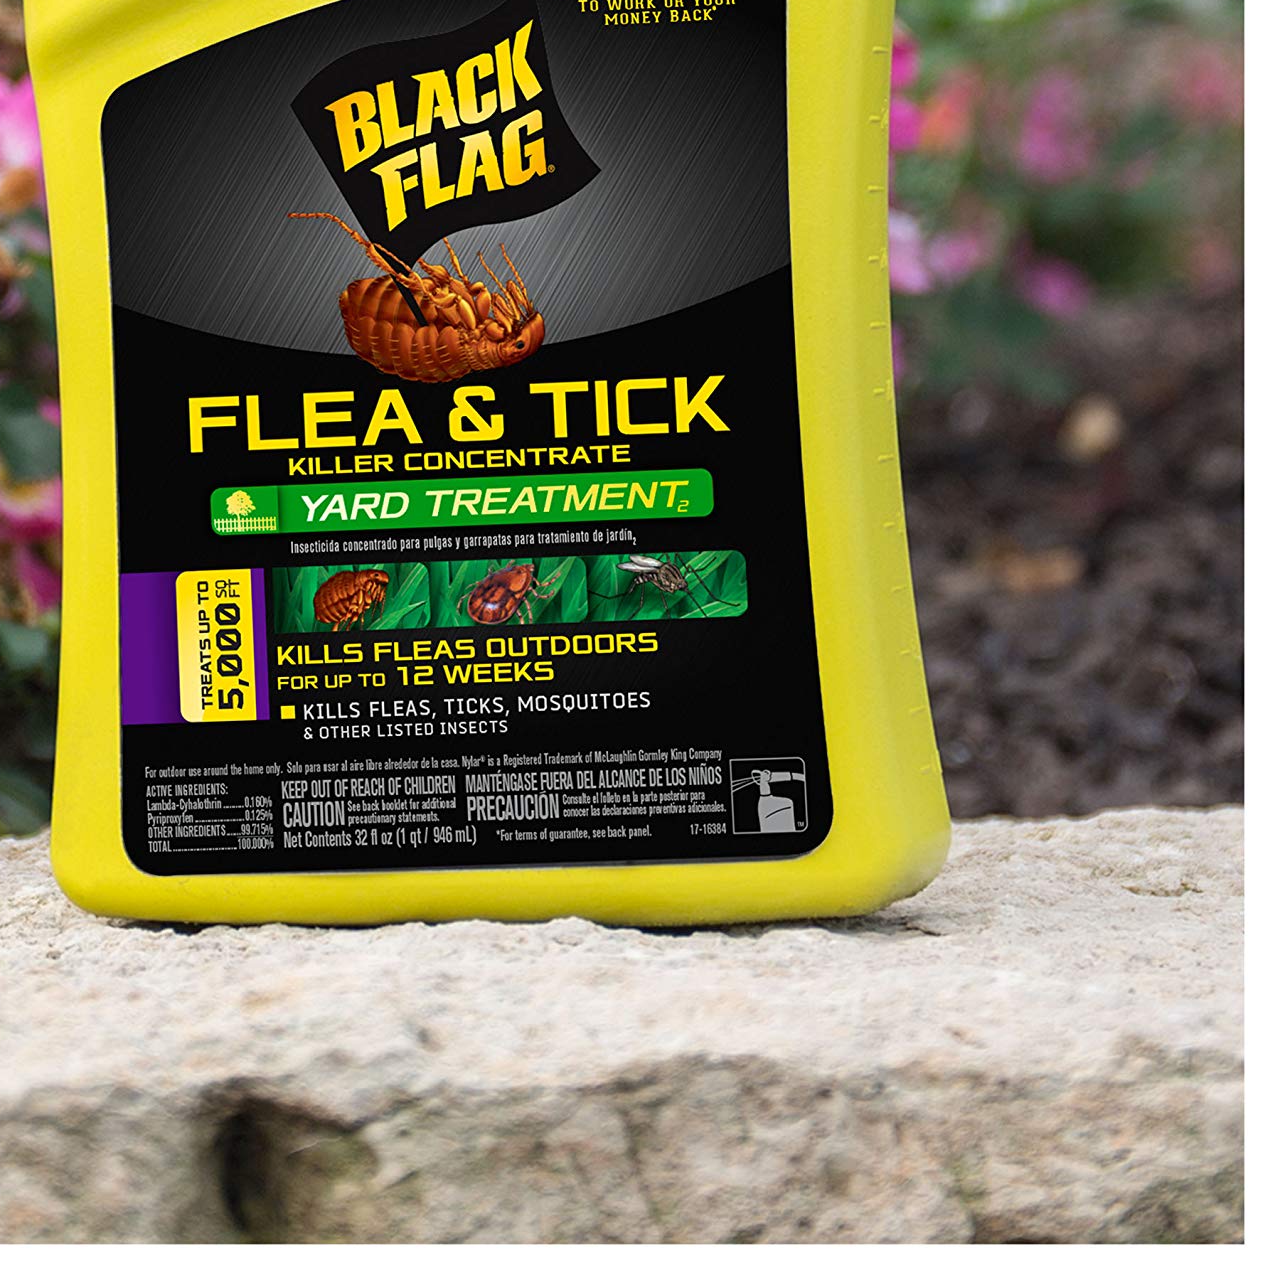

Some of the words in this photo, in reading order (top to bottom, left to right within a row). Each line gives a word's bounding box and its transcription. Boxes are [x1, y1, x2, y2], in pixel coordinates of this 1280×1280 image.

[578, 0, 598, 12] TO
[605, 11, 661, 25] MONEY
[324, 19, 543, 172] BLACK
[189, 389, 423, 453] FLEA
[449, 386, 504, 441] &
[530, 375, 730, 438] TICK
[289, 455, 393, 475] KILLER
[404, 445, 630, 470] CONCENTRATE
[302, 492, 409, 521] YARD
[291, 540, 339, 553] Insecticida
[343, 538, 397, 551] concentrado
[400, 539, 420, 551] para
[424, 536, 452, 551] pulgas
[455, 537, 460, 549] y
[464, 534, 511, 549] garrapatas
[515, 534, 534, 547] para
[538, 531, 589, 544] tratamiento
[593, 530, 603, 542] de
[197, 581, 209, 605] TO
[215, 579, 228, 598] SQ
[228, 579, 240, 598] FT
[198, 609, 210, 634] UP
[215, 603, 250, 709] 5,000
[277, 643, 363, 665] KILLS
[374, 639, 475, 661] FLEAS
[486, 633, 658, 657] OUTDOORS
[200, 638, 213, 710] TREATS
[278, 676, 318, 690] FOR
[325, 675, 351, 688] UP
[358, 673, 385, 687] TO
[397, 666, 433, 685] 12
[443, 661, 554, 684] WEEKS
[304, 702, 360, 720] KILLS
[370, 700, 436, 719] FLEAS,
[444, 697, 509, 716] TICKS,
[518, 692, 650, 712] MOSQUITOES
[304, 727, 312, 739] &
[320, 725, 370, 739] OTHER
[378, 723, 433, 737] LISTED
[440, 720, 507, 734] INSECTS
[145, 767, 156, 778] For
[159, 766, 186, 778] outdoor
[189, 768, 201, 776] use
[204, 764, 228, 776] around
[231, 764, 242, 775] the
[244, 763, 263, 774] home
[266, 762, 283, 776] only.
[287, 762, 302, 773] Solo
[305, 764, 321, 775] para
[341, 760, 347, 771] al
[350, 760, 364, 771] aire
[366, 759, 382, 770] libre
[384, 758, 418, 770] alrededor
[421, 757, 430, 768] de
[431, 757, 438, 768] la
[441, 759, 460, 768] casa.
[488, 755, 494, 766] is
[497, 758, 500, 766] a
[503, 753, 542, 768] Registered
[544, 752, 583, 764] Trademark
[585, 751, 592, 763] of
[595, 750, 637, 764] McLaughlin
[638, 749, 668, 763] Gormley
[671, 748, 687, 762] King
[689, 748, 722, 761] Company
[281, 780, 308, 799] KEEP
[311, 780, 331, 798] OUT
[335, 779, 348, 797] OF
[351, 778, 385, 797] REACH
[388, 777, 401, 795] OF
[404, 775, 455, 795] CHILDREN
[466, 770, 538, 793] MANTÉNGASE
[540, 771, 573, 791] FUERA
[577, 771, 596, 789] DEL
[599, 769, 646, 788] ALCANCE
[649, 768, 663, 786] DE
[666, 768, 686, 786] LOS
[689, 763, 722, 785] NIÑOS
[146, 785, 172, 797] ACTIVE
[175, 783, 228, 796] INGREDIENTS:
[592, 793, 599, 804] el
[623, 794, 631, 803] en
[632, 792, 638, 802] la
[641, 791, 657, 804] parte
[659, 791, 688, 804] posterior
[690, 792, 705, 803] para
[283, 801, 345, 828] CAUTION
[347, 800, 360, 812] See
[362, 800, 379, 811] back
[409, 798, 419, 809] for
[422, 797, 456, 809] additional
[466, 790, 560, 821] PRECAUCIÓN
[563, 808, 589, 817] conocer
[591, 805, 600, 816] las
[348, 813, 396, 827] precautionary
[398, 811, 439, 822] statements.
[690, 823, 726, 835] 17-16384
[148, 826, 173, 838] OTHER
[175, 825, 226, 837] INGREDIENTS
[284, 832, 302, 848] Net
[305, 831, 352, 847] Contents
[355, 829, 368, 846] 32
[371, 829, 377, 845] fl
[381, 832, 393, 845] oz
[396, 827, 405, 848] (1
[410, 828, 421, 848] qt
[433, 826, 452, 843] 946
[455, 825, 476, 845] mL)
[515, 830, 537, 840] terms
[540, 828, 547, 839] of
[549, 828, 590, 842] guarantee,
[593, 829, 606, 838] see
[607, 825, 626, 837] back
[629, 825, 652, 839] panel.
[148, 841, 172, 852] TOTAL
